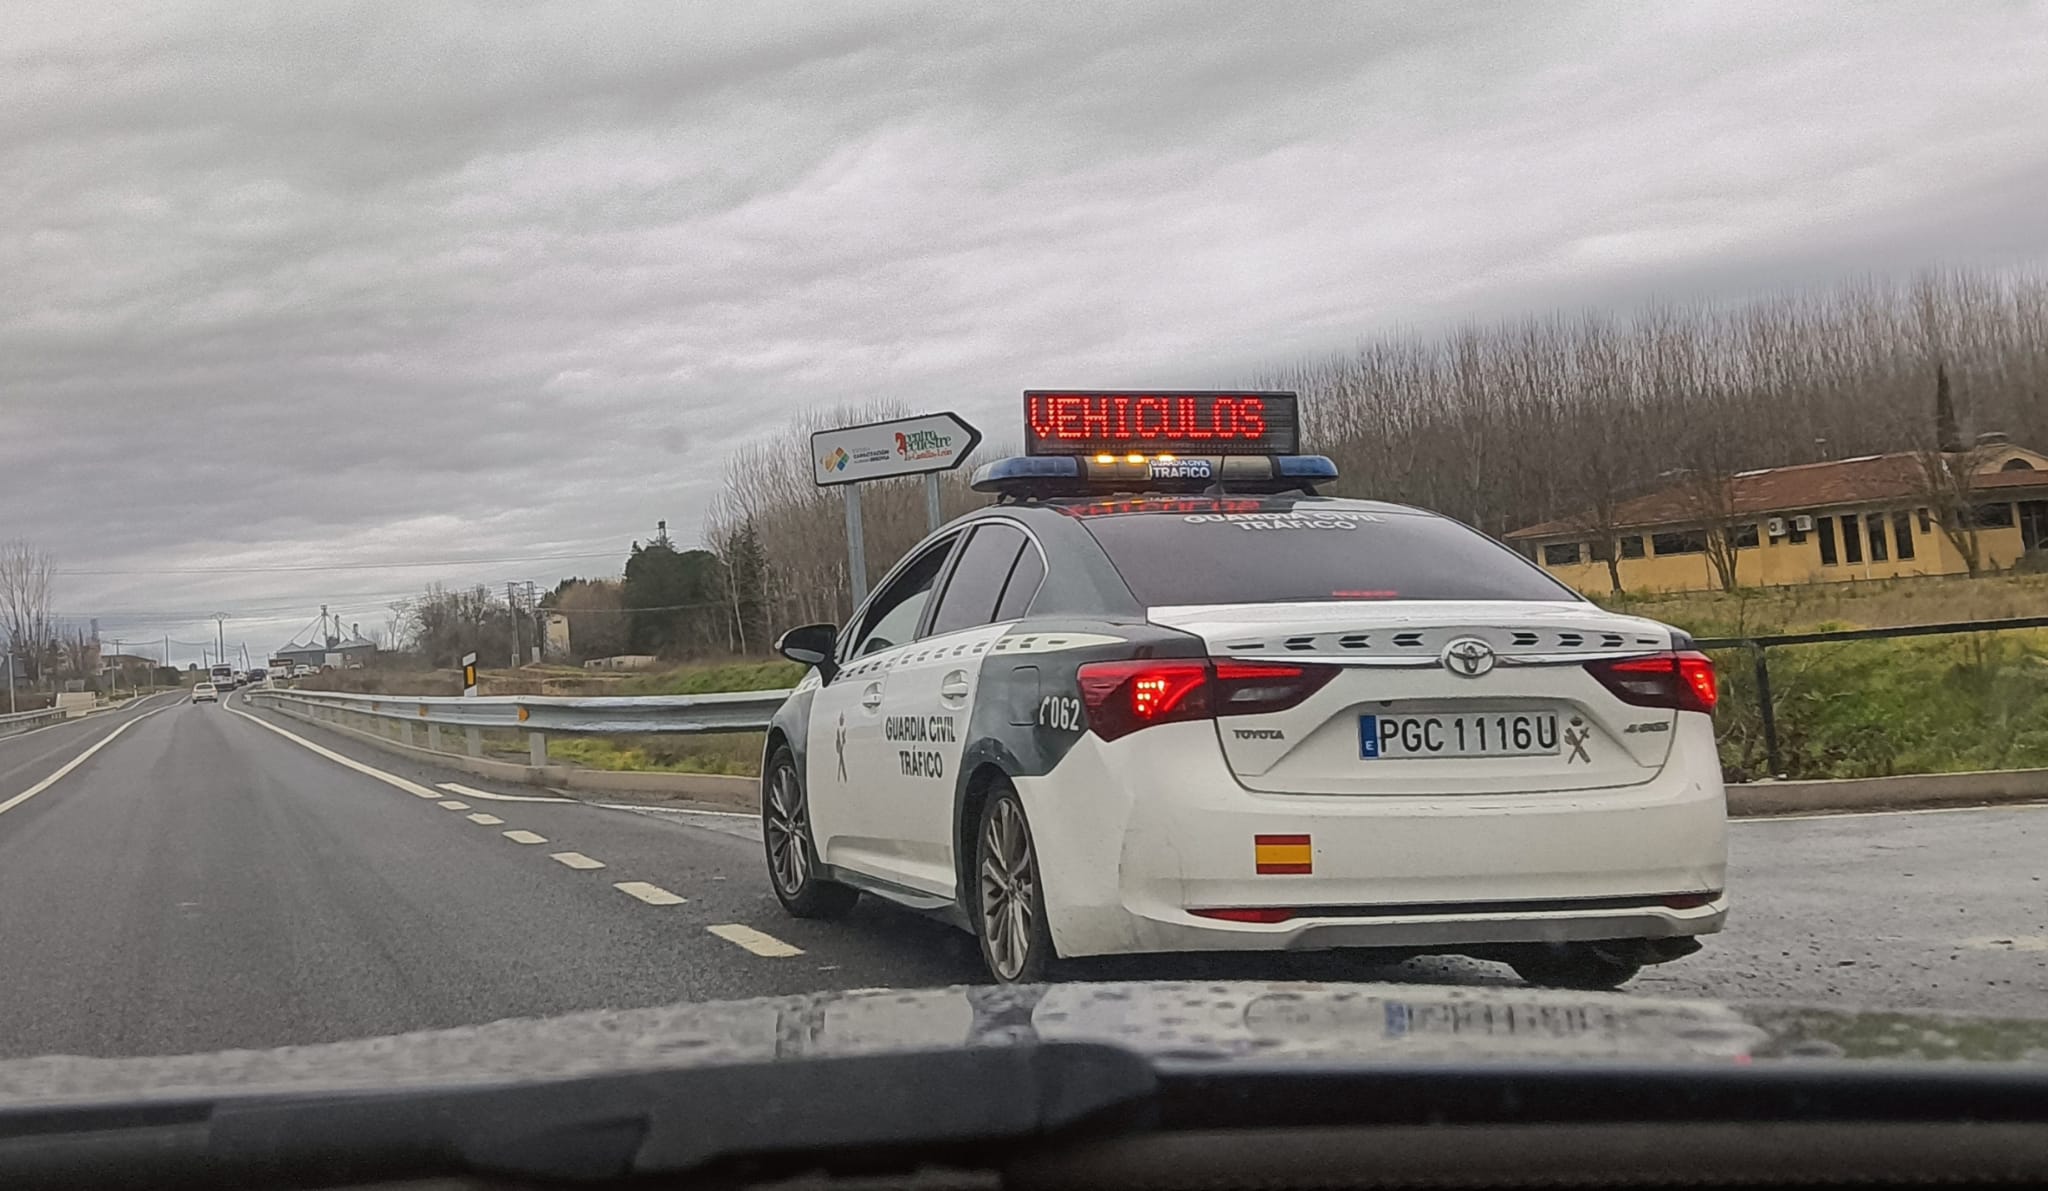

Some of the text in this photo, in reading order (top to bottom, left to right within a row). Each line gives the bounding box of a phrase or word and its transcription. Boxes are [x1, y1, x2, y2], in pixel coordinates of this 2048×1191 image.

[1031, 397, 1265, 438] VEHICULOS
[1153, 466, 1210, 478] TRAFICO
[1184, 512, 1385, 524] GUARDIA CIVIL
[1232, 519, 1357, 530] TRAFICO
[1050, 696, 1080, 731] 062
[885, 715, 956, 742] GUARDIA CIVIL
[1232, 729, 1285, 740] TOYOTA
[1365, 740, 1375, 751] E
[1380, 718, 1444, 753] PGC
[899, 745, 943, 778] TRÁFICO
